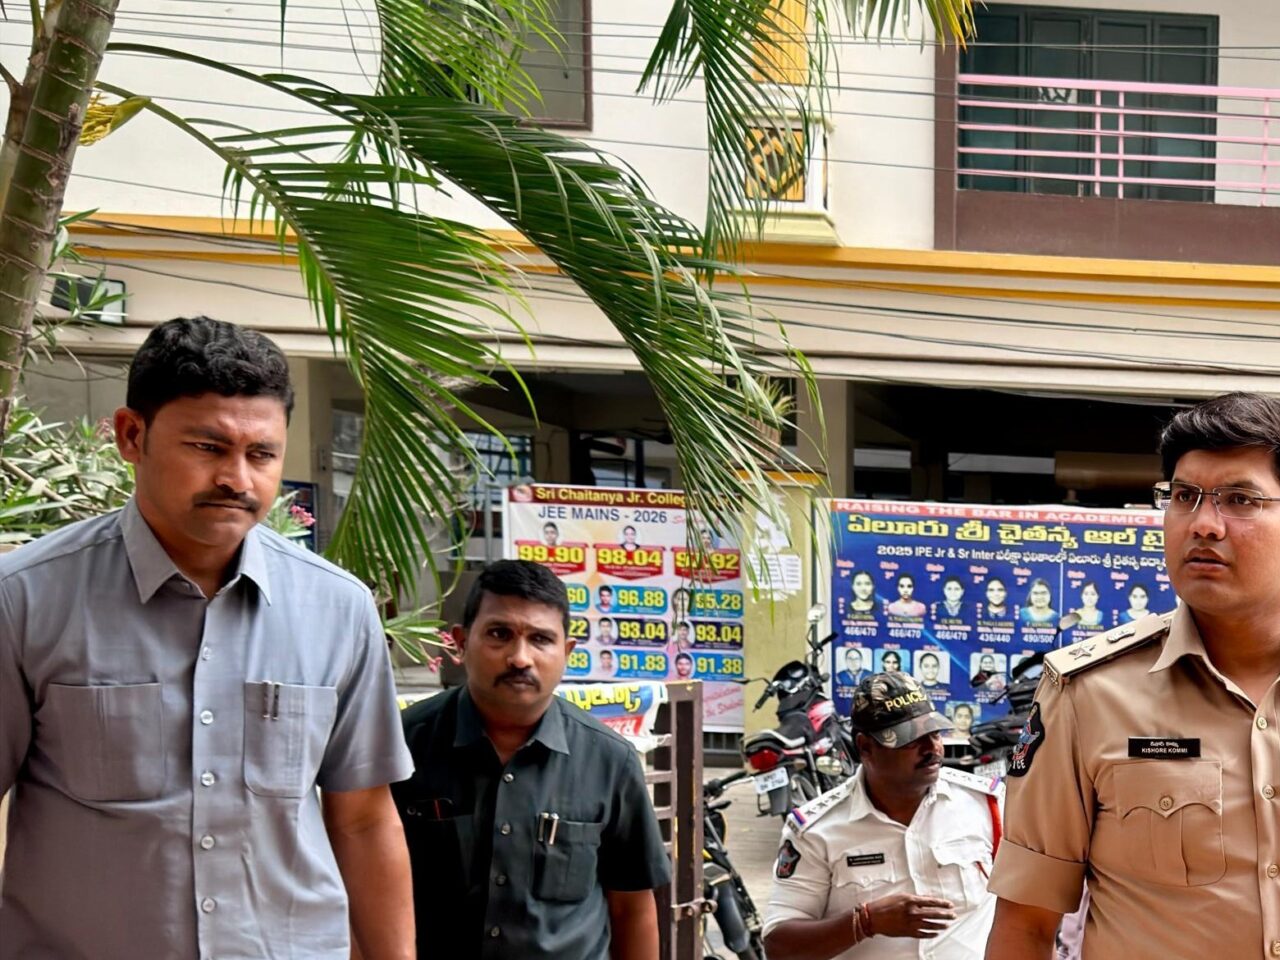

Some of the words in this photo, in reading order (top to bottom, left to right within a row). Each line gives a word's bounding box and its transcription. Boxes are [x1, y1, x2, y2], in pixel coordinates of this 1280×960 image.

[535, 487, 555, 499] Sri
[559, 489, 623, 504] Chaitanya
[626, 493, 644, 504] Jr.
[647, 493, 688, 508] Colleg
[538, 506, 567, 519] JEE
[571, 507, 620, 521] MAINS
[633, 510, 668, 523] 2026
[836, 502, 920, 514] RAISING
[927, 506, 965, 516] THE
[972, 507, 1012, 518] BAR
[1018, 511, 1039, 520] IN
[1048, 512, 1146, 524] ACADEMIC
[955, 519, 990, 541] శ్రీ
[997, 523, 1079, 549] చైతన్య
[597, 549, 662, 567] 98.04
[877, 545, 913, 556] 2025
[915, 546, 932, 557] IPE
[935, 547, 946, 558] Jr
[948, 548, 956, 558] &
[958, 548, 970, 559] Sr
[972, 549, 994, 560] Inter
[618, 590, 665, 607] 96.88
[619, 622, 665, 640] 93.04
[696, 625, 742, 642] 93.04
[619, 654, 666, 671] 91.83
[697, 657, 742, 674] 91.38
